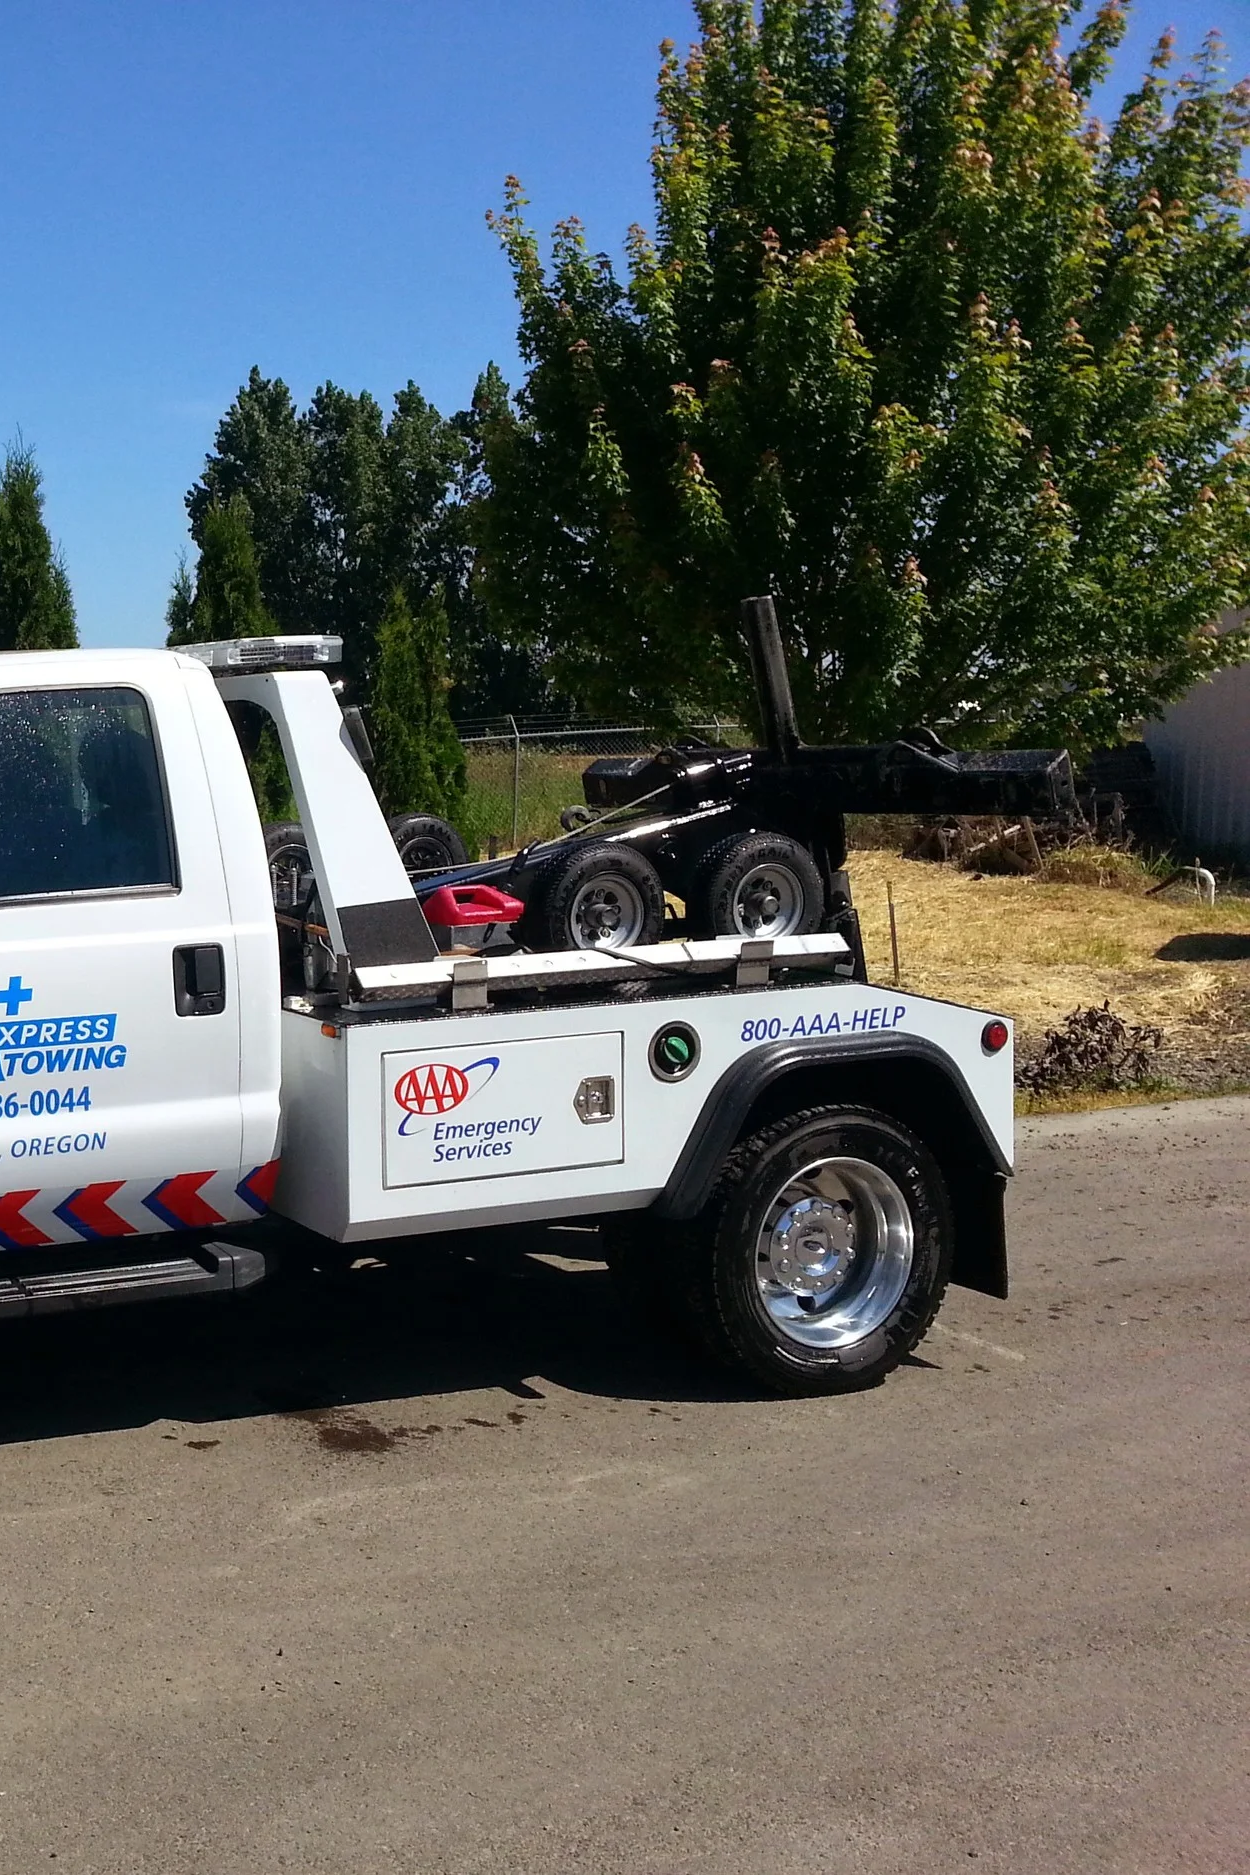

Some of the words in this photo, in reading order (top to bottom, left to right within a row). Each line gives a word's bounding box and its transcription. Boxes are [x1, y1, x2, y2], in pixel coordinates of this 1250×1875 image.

[741, 1005, 906, 1042] 800-AAA-HELP
[4, 1044, 128, 1078] TOWING
[398, 1064, 467, 1115] AAA
[433, 1116, 543, 1142] Emergency
[10, 1131, 107, 1159] OREGON
[433, 1138, 513, 1163] Services
